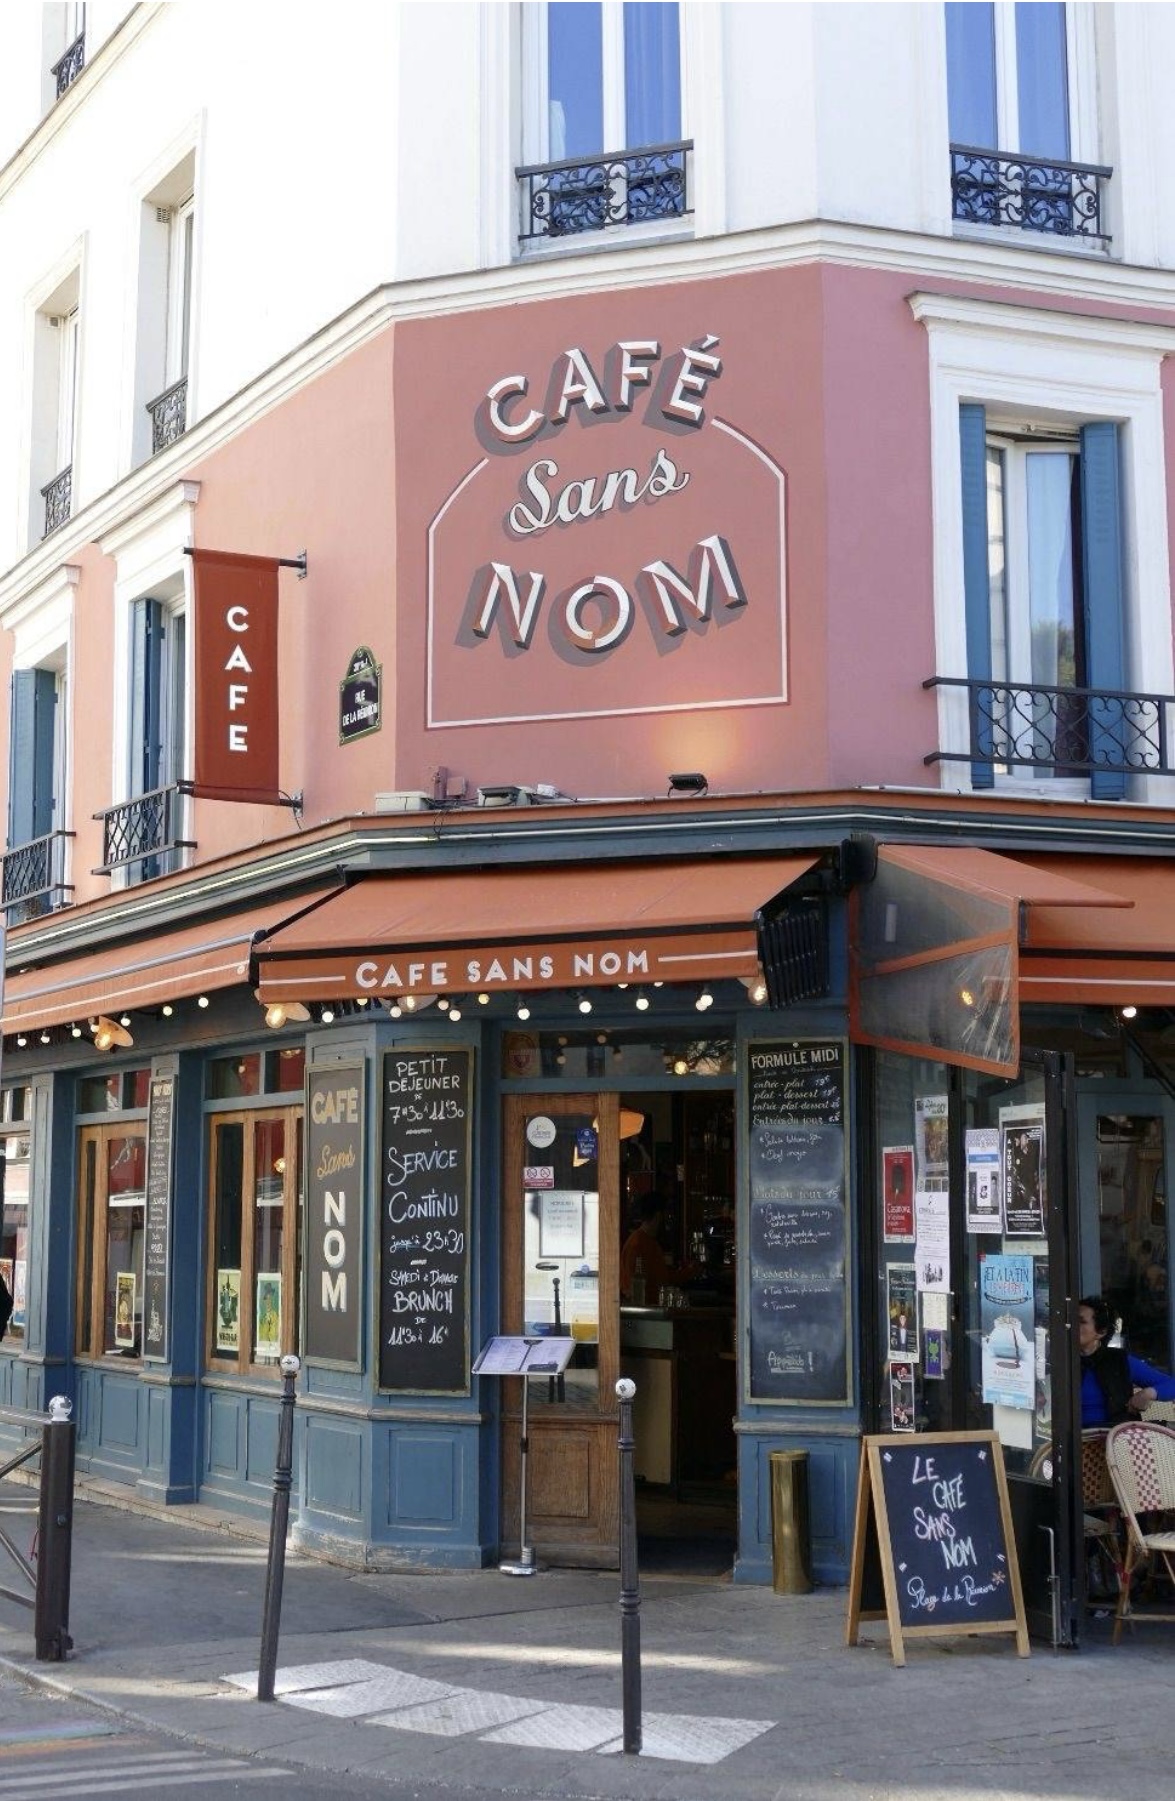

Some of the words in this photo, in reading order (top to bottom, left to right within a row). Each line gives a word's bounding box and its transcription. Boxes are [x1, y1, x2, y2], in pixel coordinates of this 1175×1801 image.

[486, 334, 722, 444] CAFÉ
[508, 449, 690, 534] Sans
[472, 535, 748, 653] NOM
[224, 606, 253, 752] CAFE
[354, 689, 366, 704] RUE
[355, 961, 448, 989] CAFE
[467, 956, 554, 983] SANS
[573, 949, 649, 977] NOM
[751, 1051, 808, 1070] FORMULE
[810, 1048, 839, 1063] MIDI
[321, 1190, 347, 1313] NOM
[391, 1288, 453, 1314] BRUNCH
[911, 1455, 940, 1485] LE
[913, 1506, 957, 1542] SANS
[940, 1536, 978, 1570] NOM
